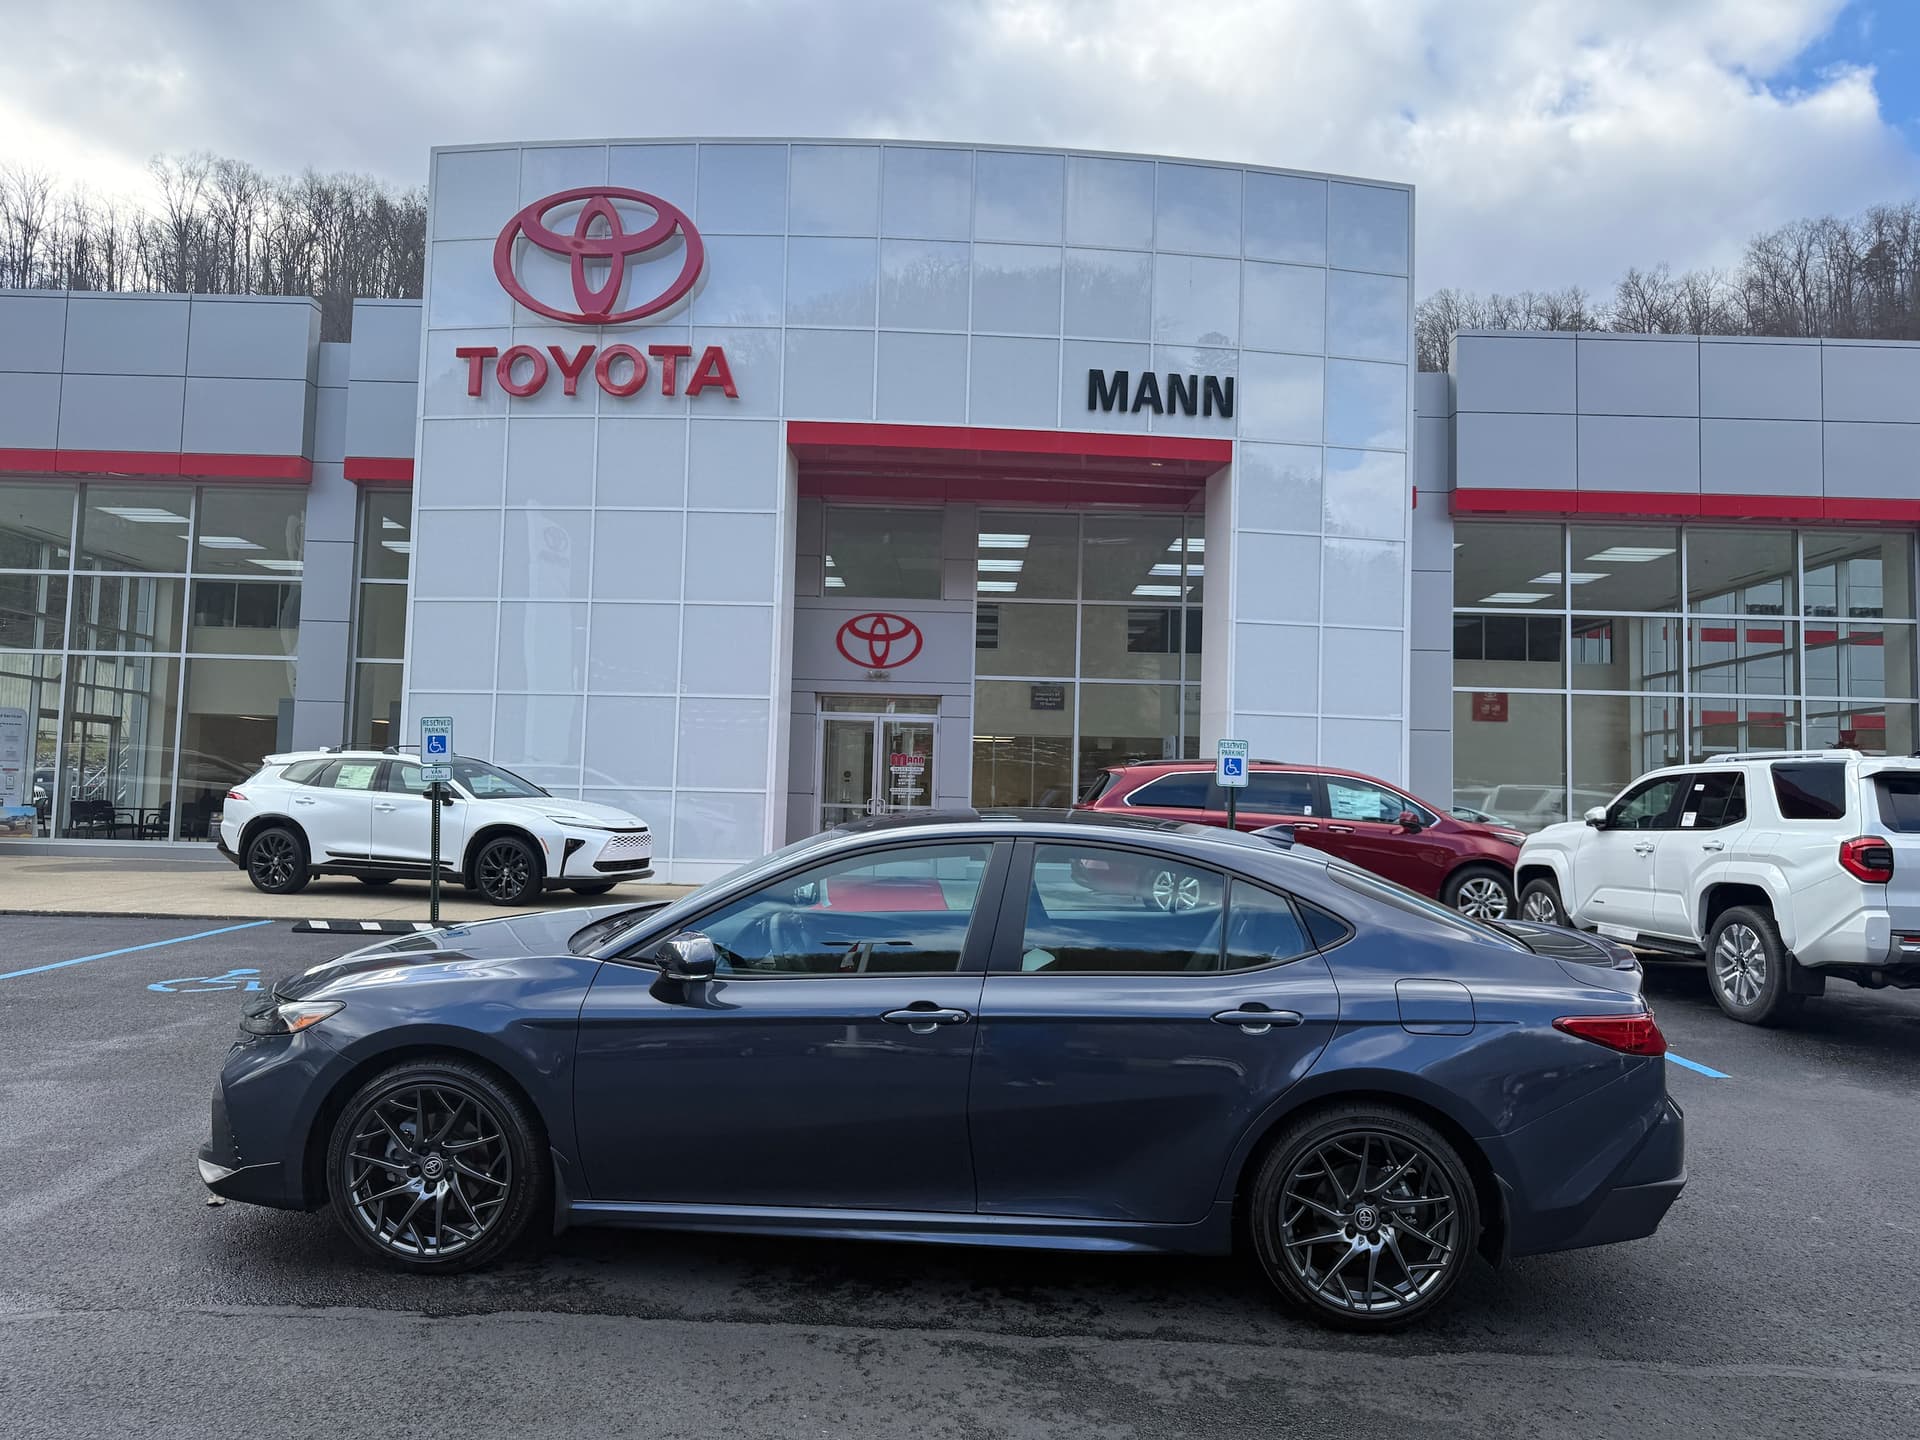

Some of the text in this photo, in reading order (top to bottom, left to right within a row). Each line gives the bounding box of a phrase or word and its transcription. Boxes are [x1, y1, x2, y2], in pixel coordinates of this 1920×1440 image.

[456, 344, 739, 398] TOYOTA
[1088, 369, 1234, 417] MANN
[422, 719, 451, 727] RESERVED
[1220, 741, 1247, 750] RESERVED
[1221, 749, 1245, 757] PARKING
